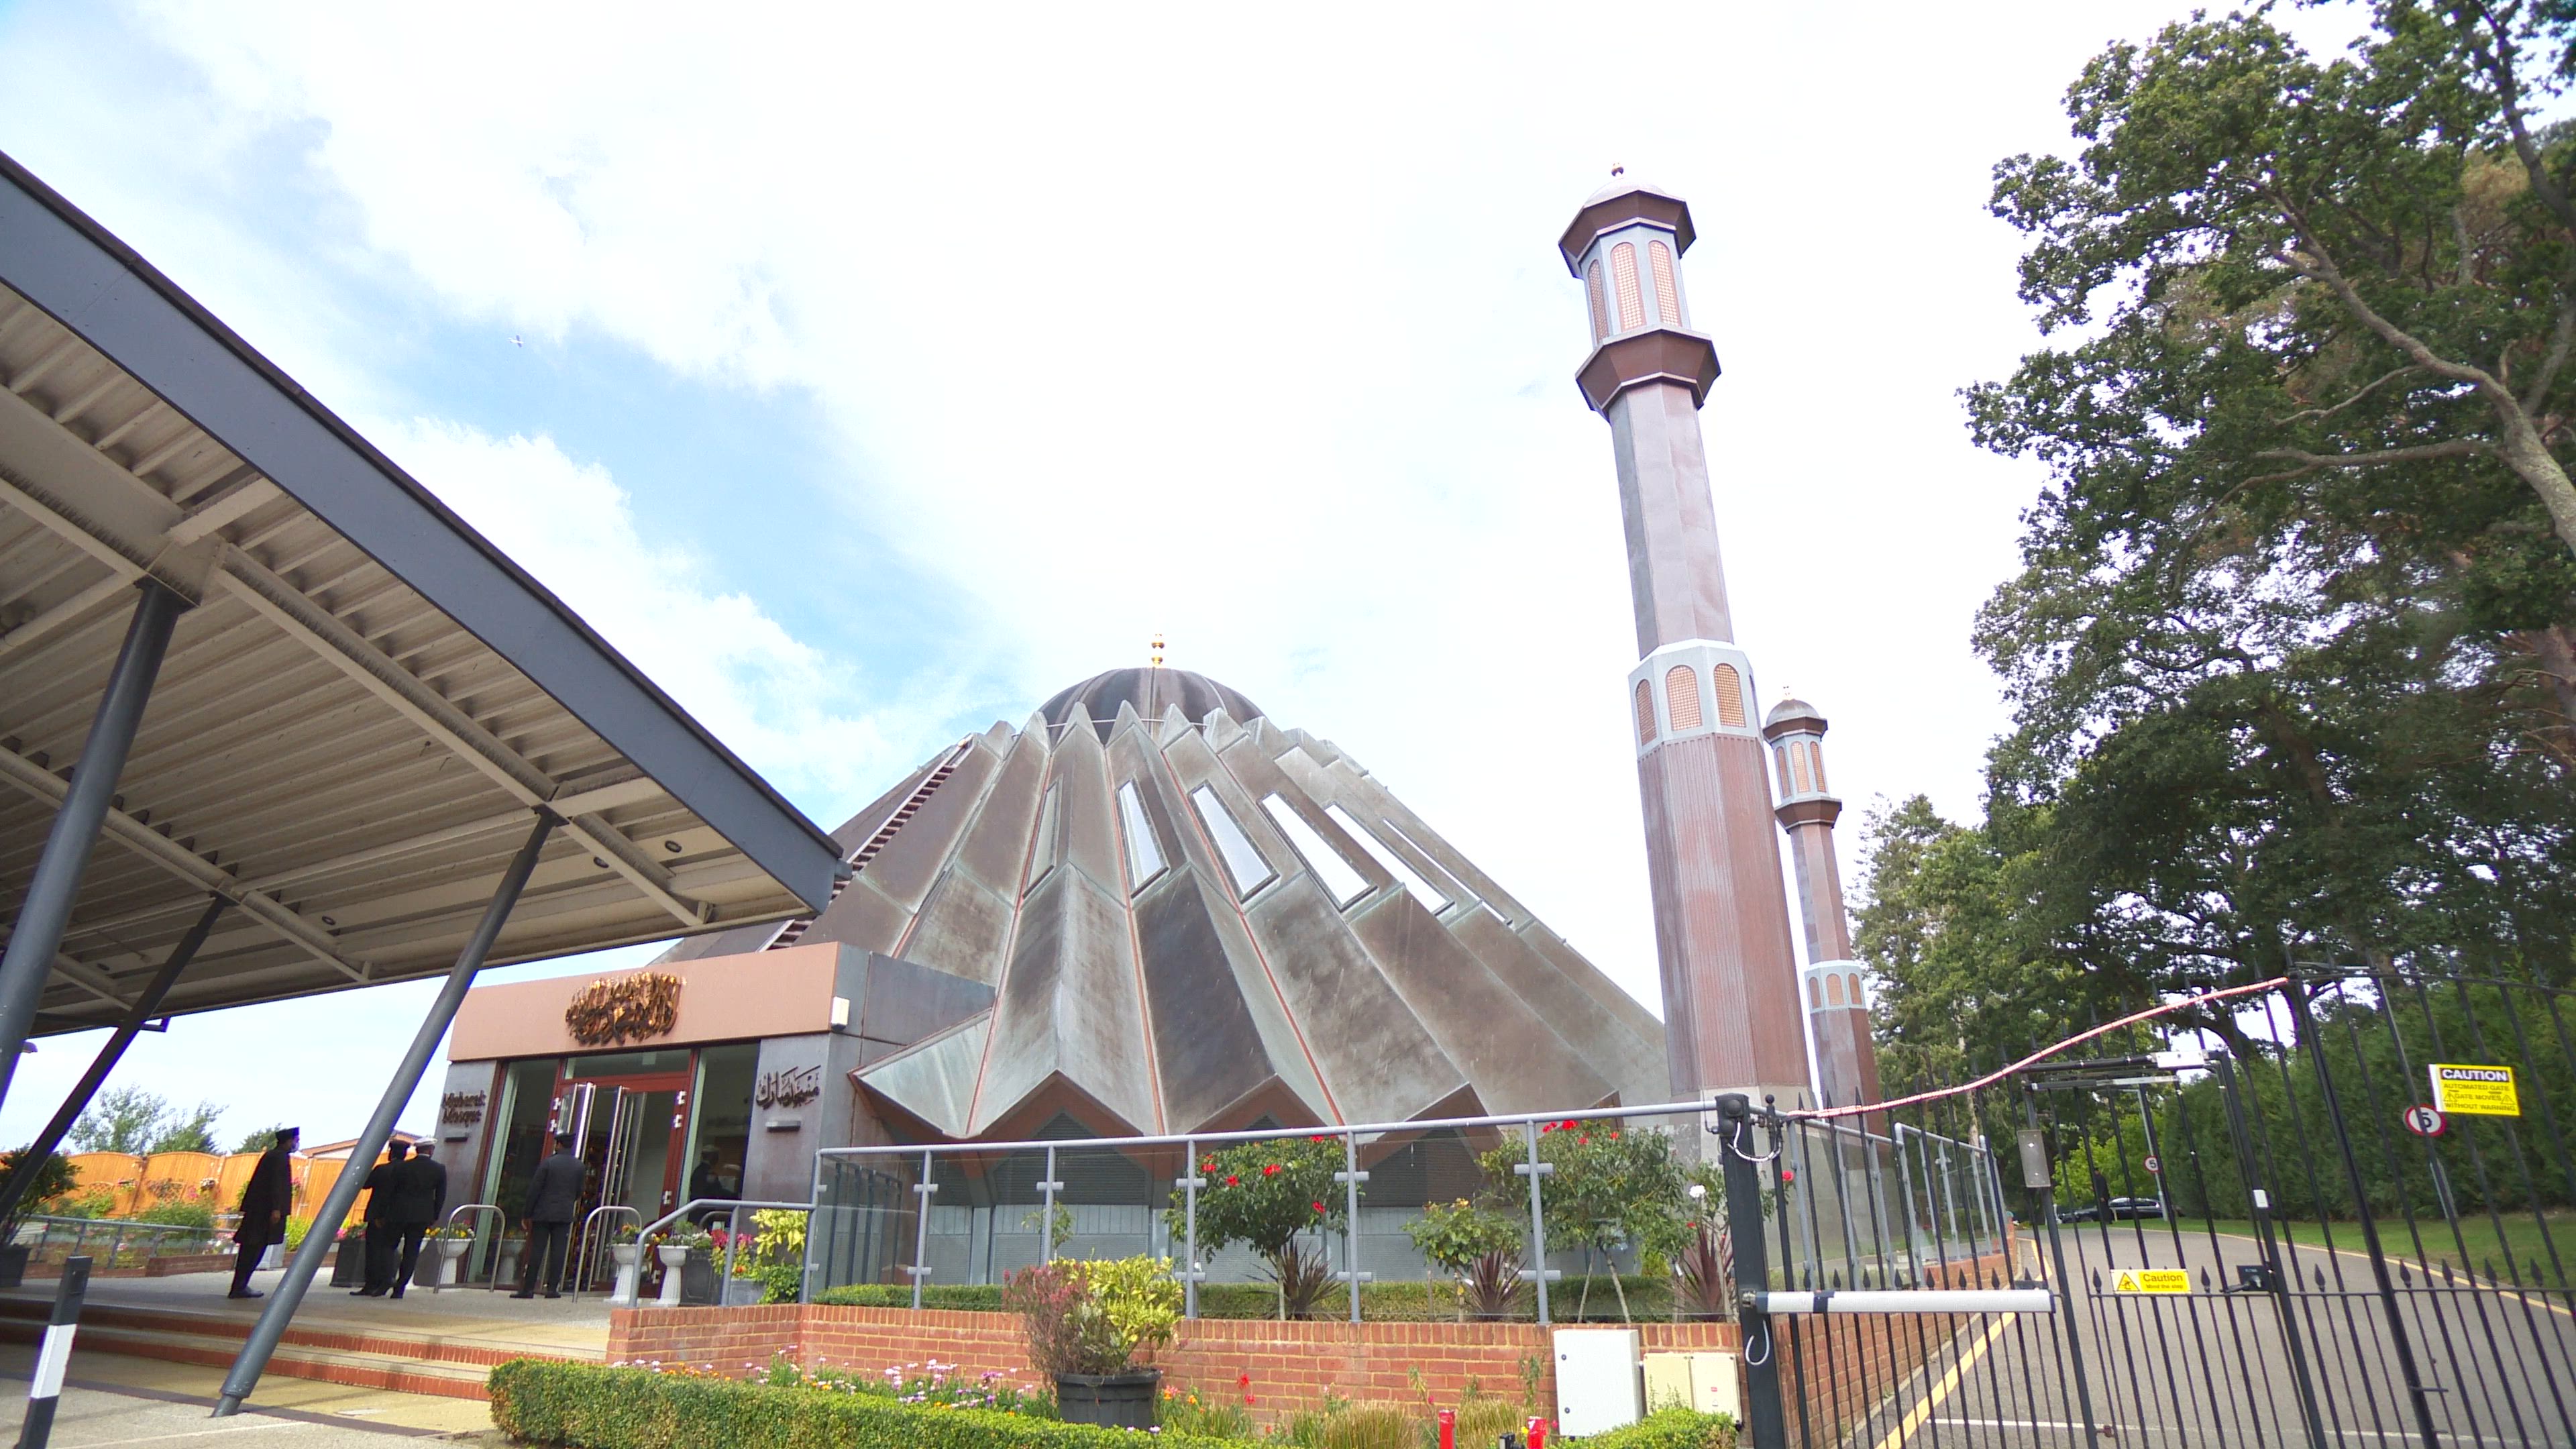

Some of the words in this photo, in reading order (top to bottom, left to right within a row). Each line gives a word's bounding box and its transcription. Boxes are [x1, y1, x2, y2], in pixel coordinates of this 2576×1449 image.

[2443, 1069, 2508, 1081] CAUTION
[2445, 1102, 2478, 1110] WITHOUT
[442, 1108, 482, 1127] Mosque
[2420, 1112, 2432, 1128] 5
[2149, 1159, 2157, 1169] 5
[2143, 1274, 2183, 1282] Caution
